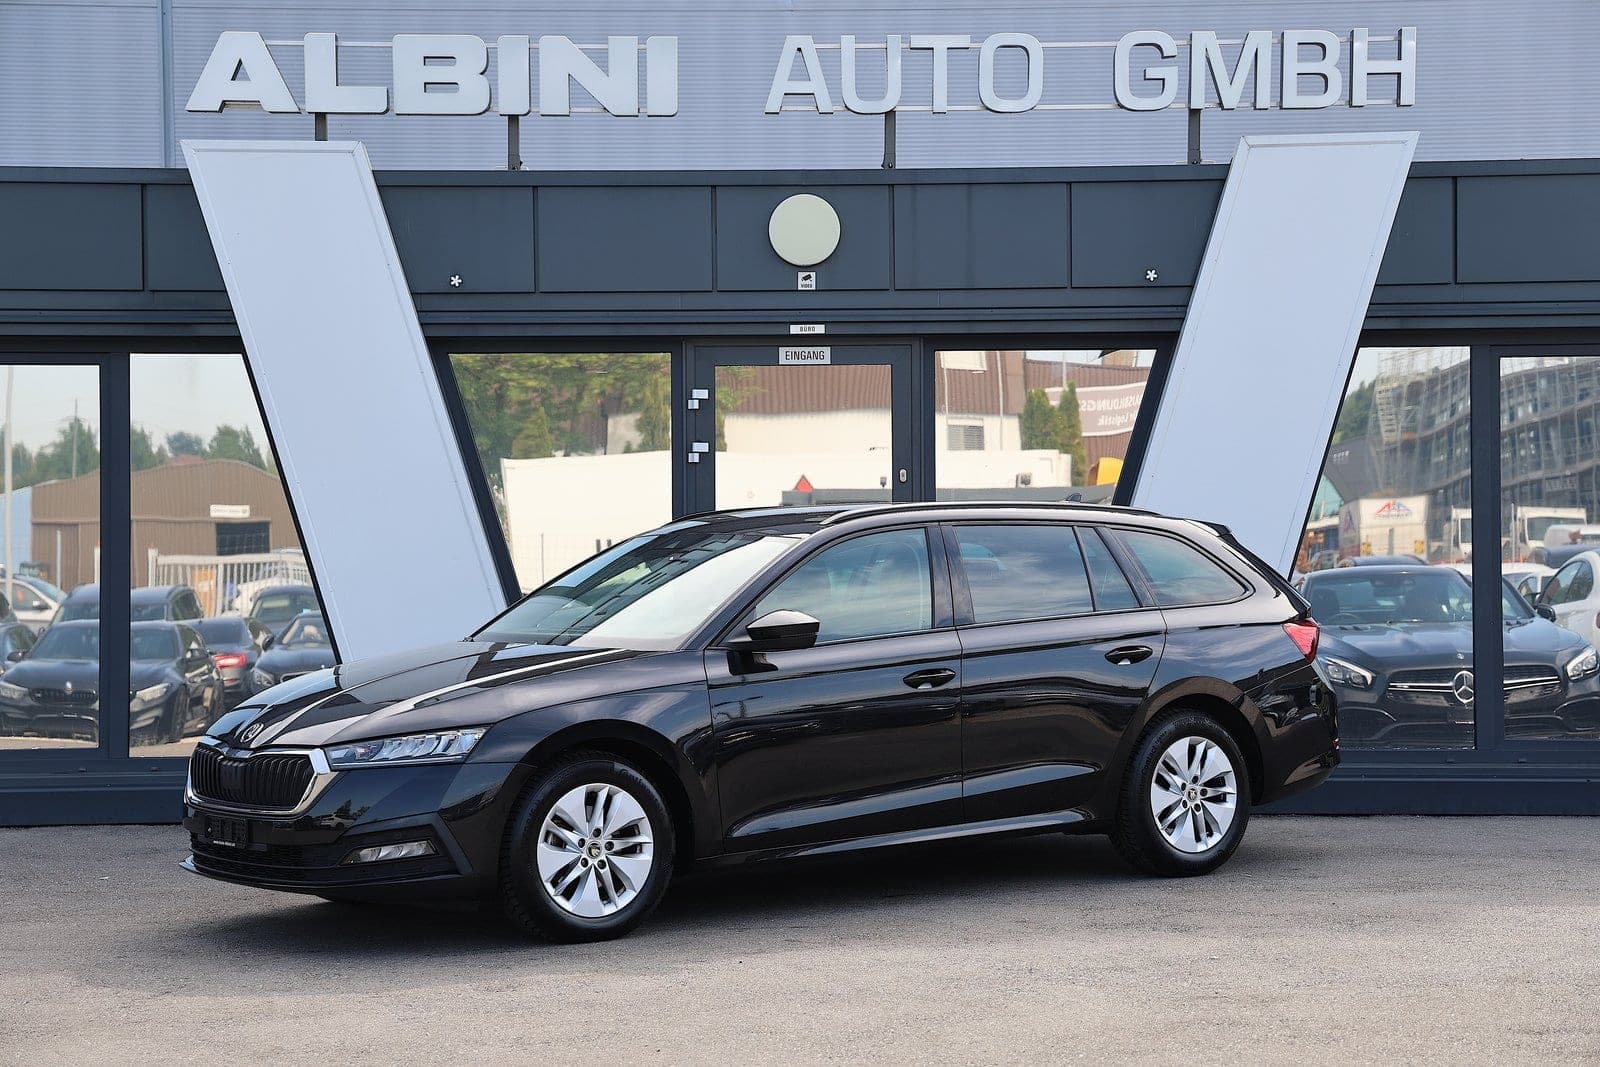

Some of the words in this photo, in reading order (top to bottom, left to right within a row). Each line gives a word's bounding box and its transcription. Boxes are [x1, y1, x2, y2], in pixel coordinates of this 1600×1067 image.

[185, 30, 679, 117] ALBINI
[764, 32, 1045, 114] AUTO
[1113, 26, 1417, 111] GMBH
[785, 350, 825, 360] EINGANG
